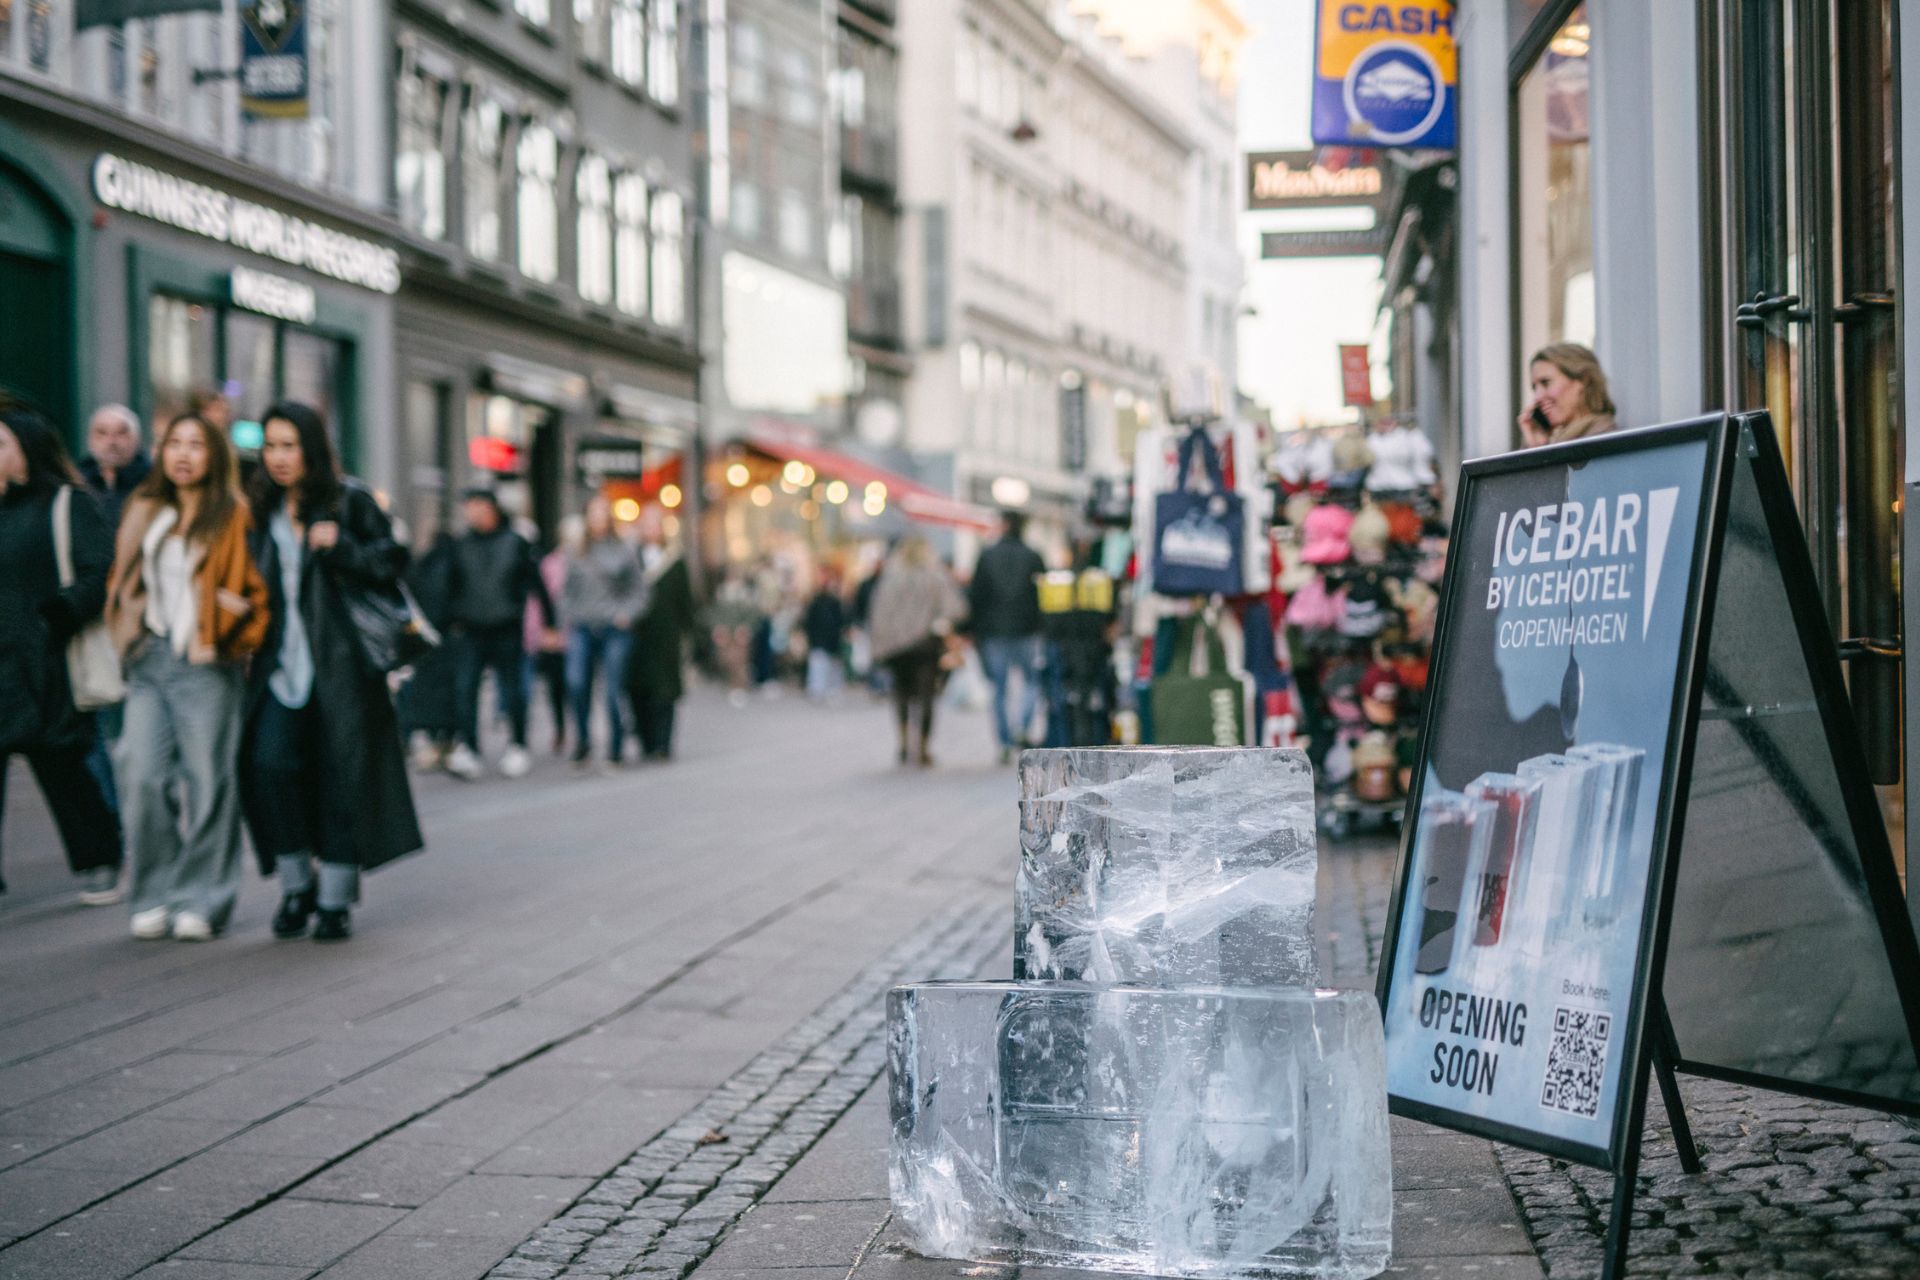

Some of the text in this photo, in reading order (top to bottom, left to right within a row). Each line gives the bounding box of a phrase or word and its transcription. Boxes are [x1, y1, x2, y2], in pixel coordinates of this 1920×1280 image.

[1340, 4, 1453, 35] CASH
[95, 152, 231, 242] GUINNESS
[229, 196, 304, 266] WORLD
[1492, 493, 1642, 568] ICEBAR
[1486, 575, 1516, 610] BY
[1499, 613, 1629, 649] COPENHAGEN
[1562, 979, 1585, 997] Book
[1420, 986, 1528, 1047] OPENING
[1430, 1041, 1499, 1096] SOON
